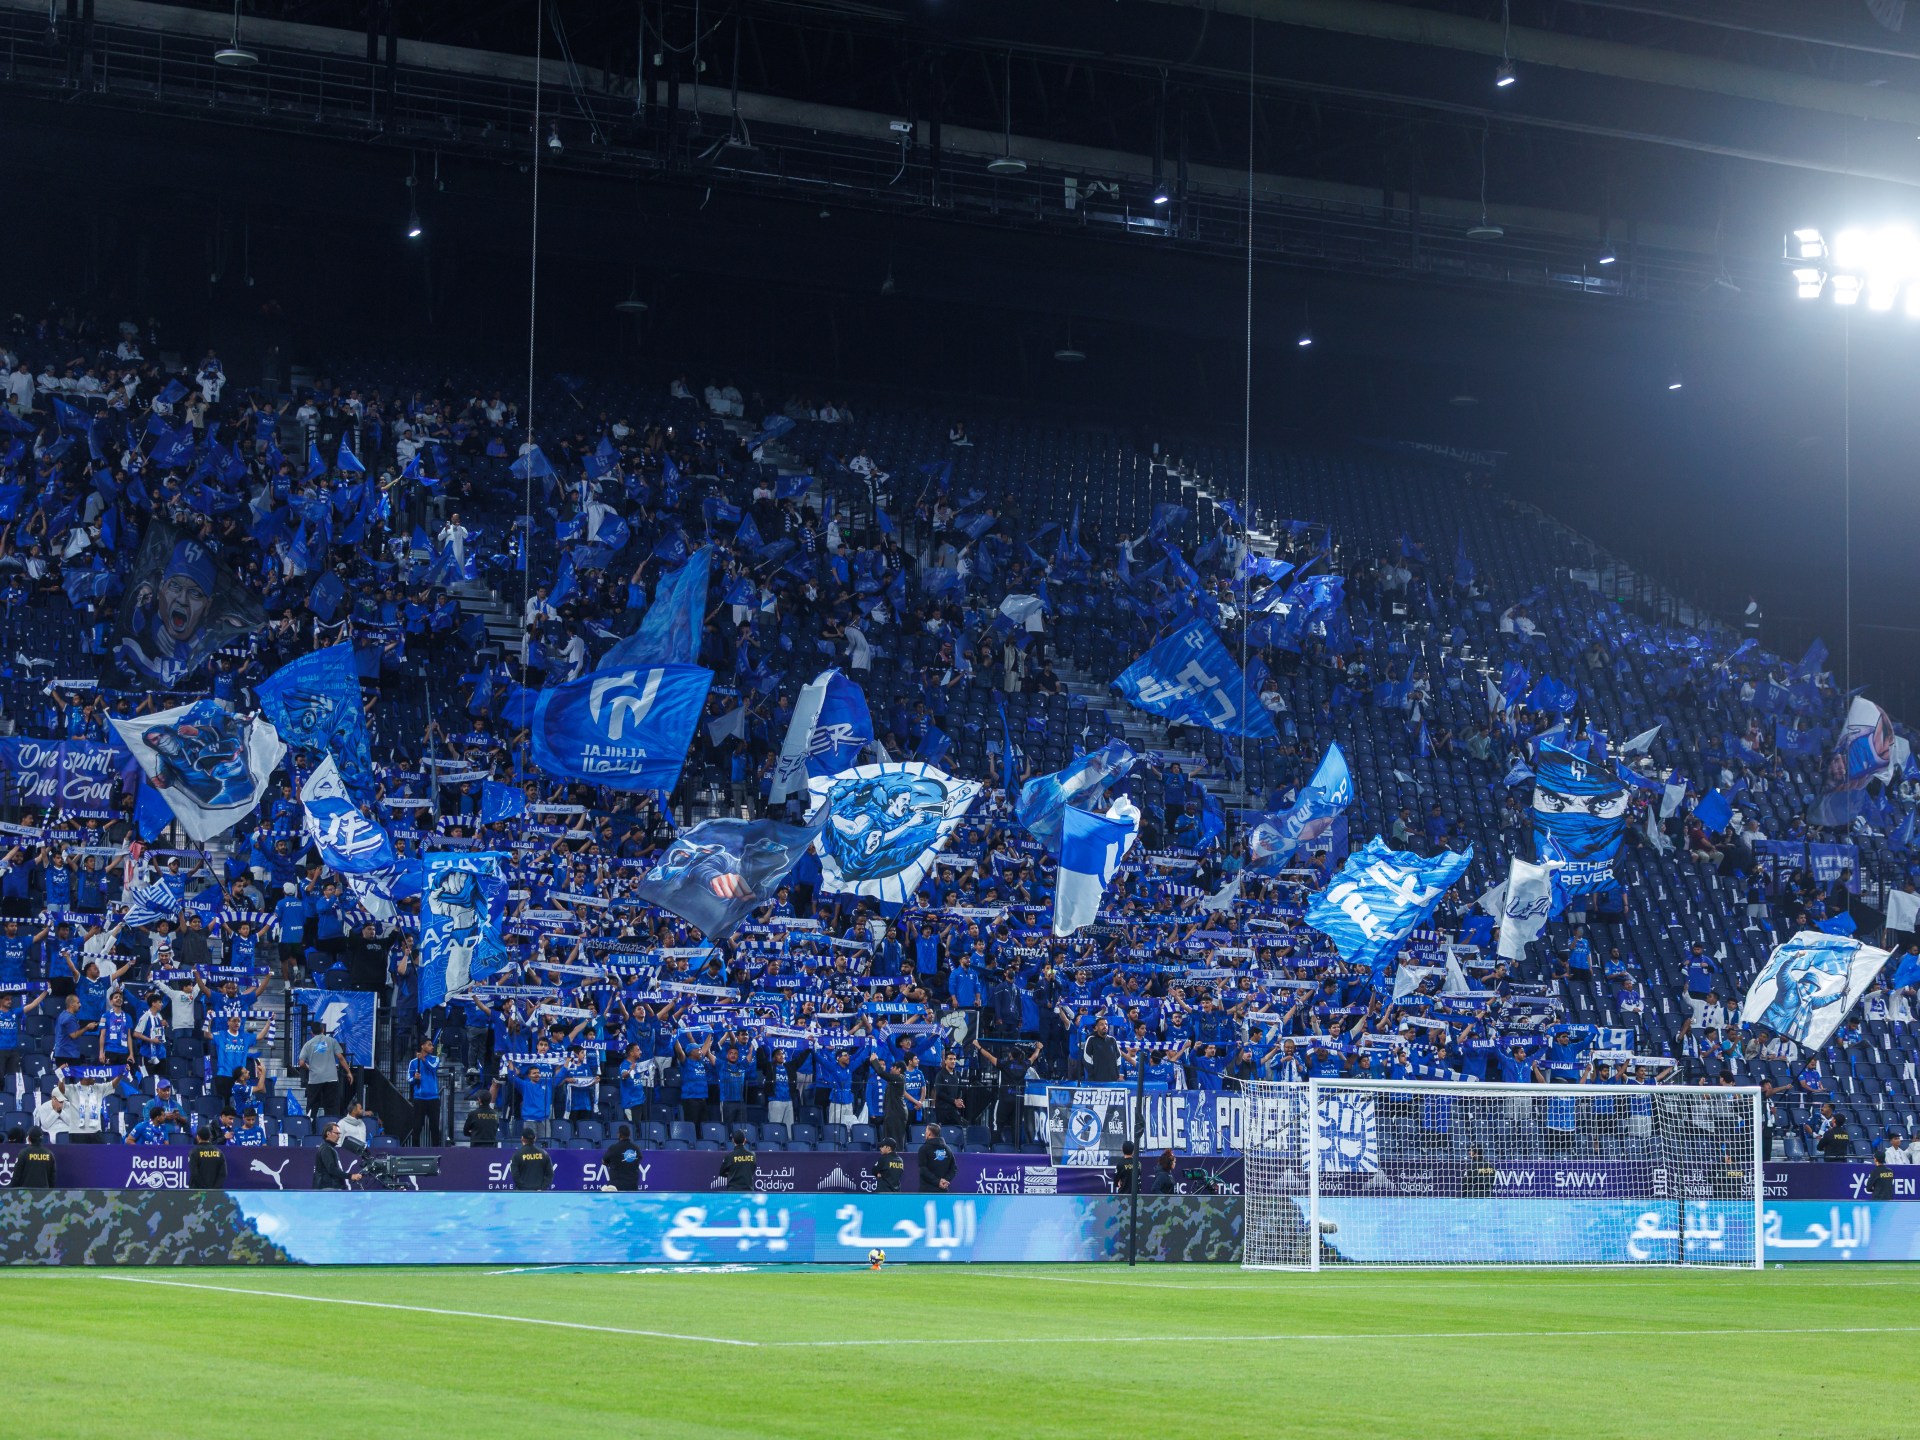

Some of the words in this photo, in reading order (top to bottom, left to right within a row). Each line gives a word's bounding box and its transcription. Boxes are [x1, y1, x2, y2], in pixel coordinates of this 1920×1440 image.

[18, 743, 59, 769] One
[17, 772, 57, 797] One
[63, 774, 112, 802] Goa
[1561, 858, 1614, 872] GETHER
[1560, 869, 1615, 885] REVER
[745, 925, 770, 933] ALHILAL
[618, 956, 650, 964] ALHILAL
[1422, 953, 1445, 961] ALHILAL
[870, 978, 894, 986] الهلال
[638, 991, 662, 999] الهلال
[1393, 997, 1424, 1005] ALHILAL
[1452, 1000, 1474, 1009] ALHILAL
[876, 1003, 909, 1012] ALHILAL
[580, 1041, 607, 1049] الهلال
[774, 1040, 797, 1048] الهلال
[830, 1038, 854, 1047] الهلال
[1510, 1037, 1533, 1045] الهلال
[83, 1068, 112, 1078] الهلال
[1050, 1091, 1070, 1104] NO
[1073, 1091, 1124, 1105] SELFIE
[477, 1113, 498, 1121] POLICE
[1109, 1122, 1123, 1130] BLUE
[1190, 1121, 1209, 1140] BLUE
[1192, 1141, 1210, 1154] POWER
[29, 1153, 50, 1161] POLICE
[200, 1150, 220, 1158] POLICE
[522, 1153, 542, 1161] POLICE
[733, 1155, 754, 1163] POLICE
[1067, 1151, 1109, 1166] ZONE
[132, 1156, 158, 1169] Red
[158, 1156, 183, 1169] Bull
[755, 1167, 795, 1178] القدية
[976, 1166, 1021, 1183] أسفار
[125, 1170, 189, 1189] MOBIL
[1493, 1171, 1535, 1186] AVVY
[1554, 1172, 1607, 1187] SAVVY
[755, 1179, 794, 1192] Qiddiya
[977, 1183, 1020, 1194] ASFAR
[1400, 1181, 1433, 1192] Qiddiya
[1741, 1187, 1788, 1196] STENTS
[662, 1194, 789, 1261] ينبع
[836, 1200, 976, 1260] الباحة
[1627, 1200, 1724, 1260] ينبع
[1764, 1206, 1871, 1259] الباحة
